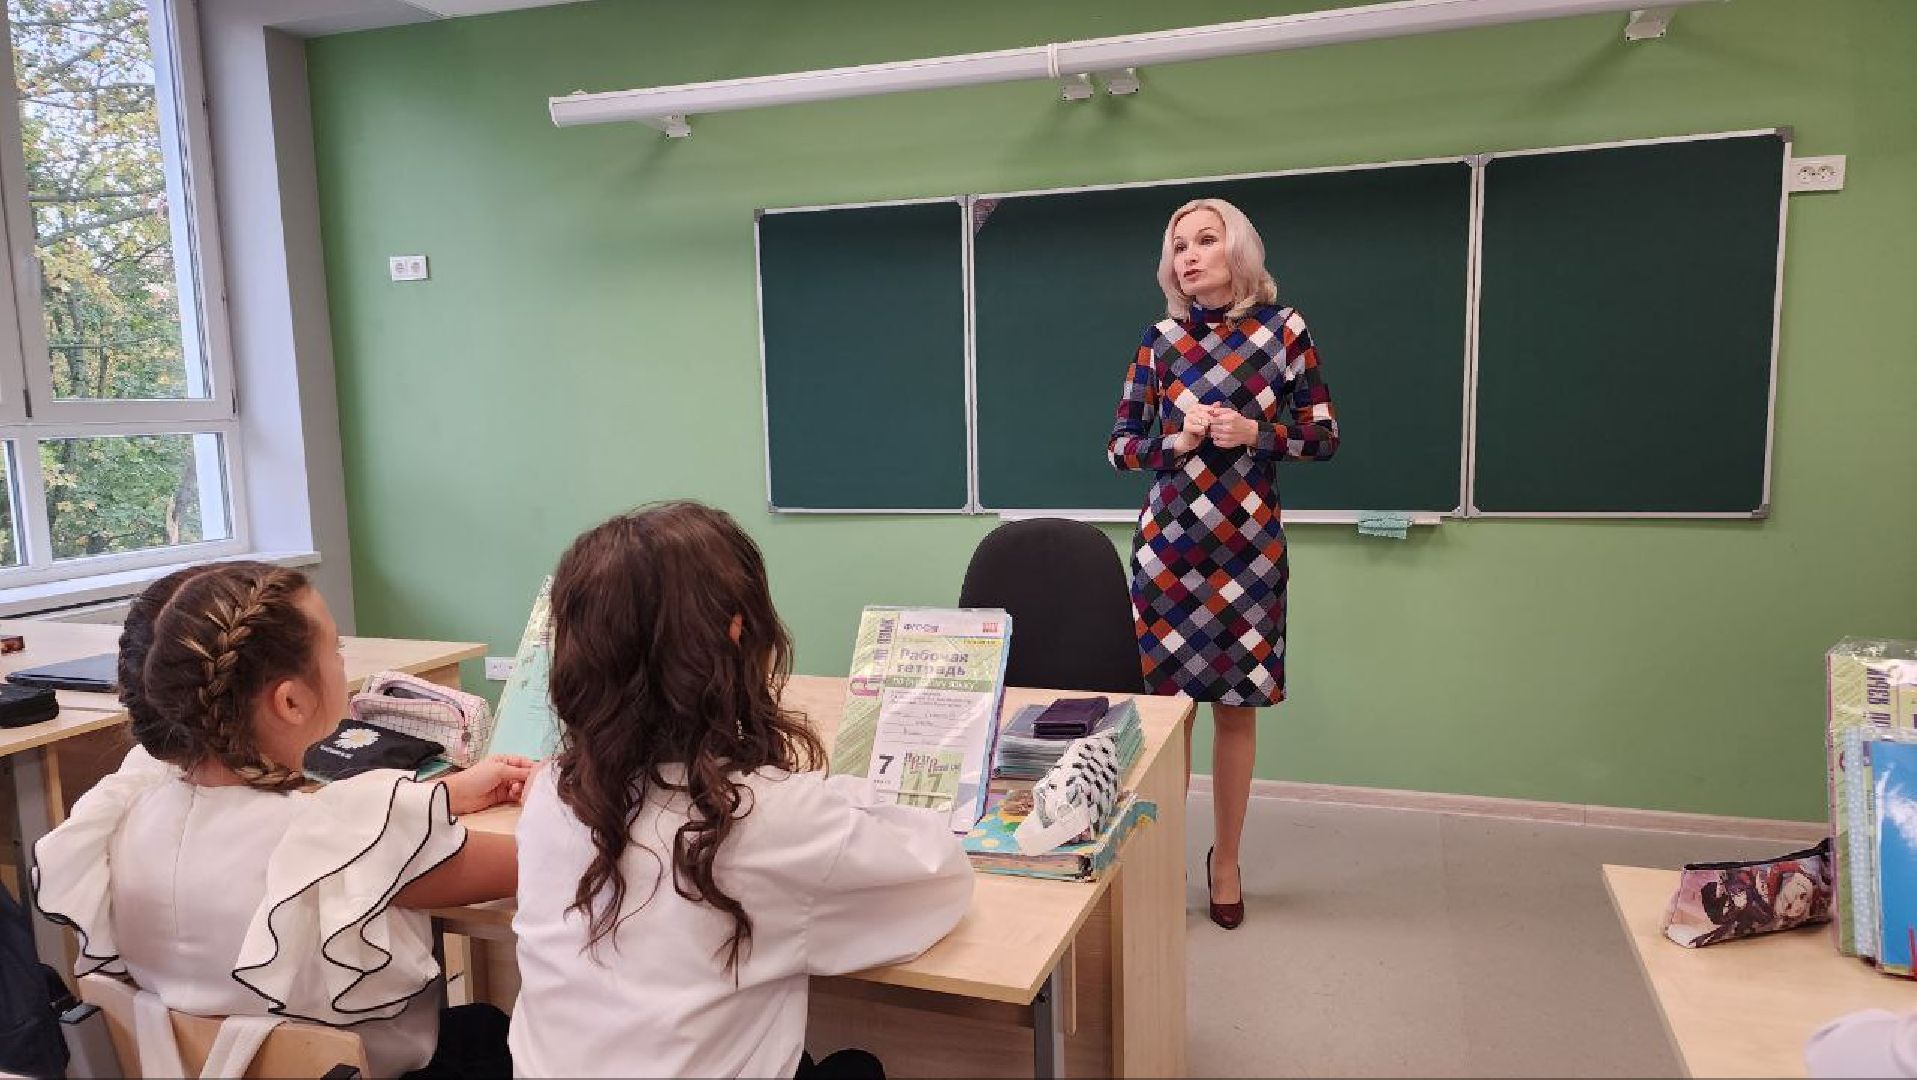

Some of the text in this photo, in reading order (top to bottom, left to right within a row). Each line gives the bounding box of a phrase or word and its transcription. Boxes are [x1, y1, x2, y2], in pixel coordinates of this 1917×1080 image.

[900, 648, 969, 663] Рабочая
[897, 664, 966, 678] тетрадь
[879, 755, 894, 775] 7
